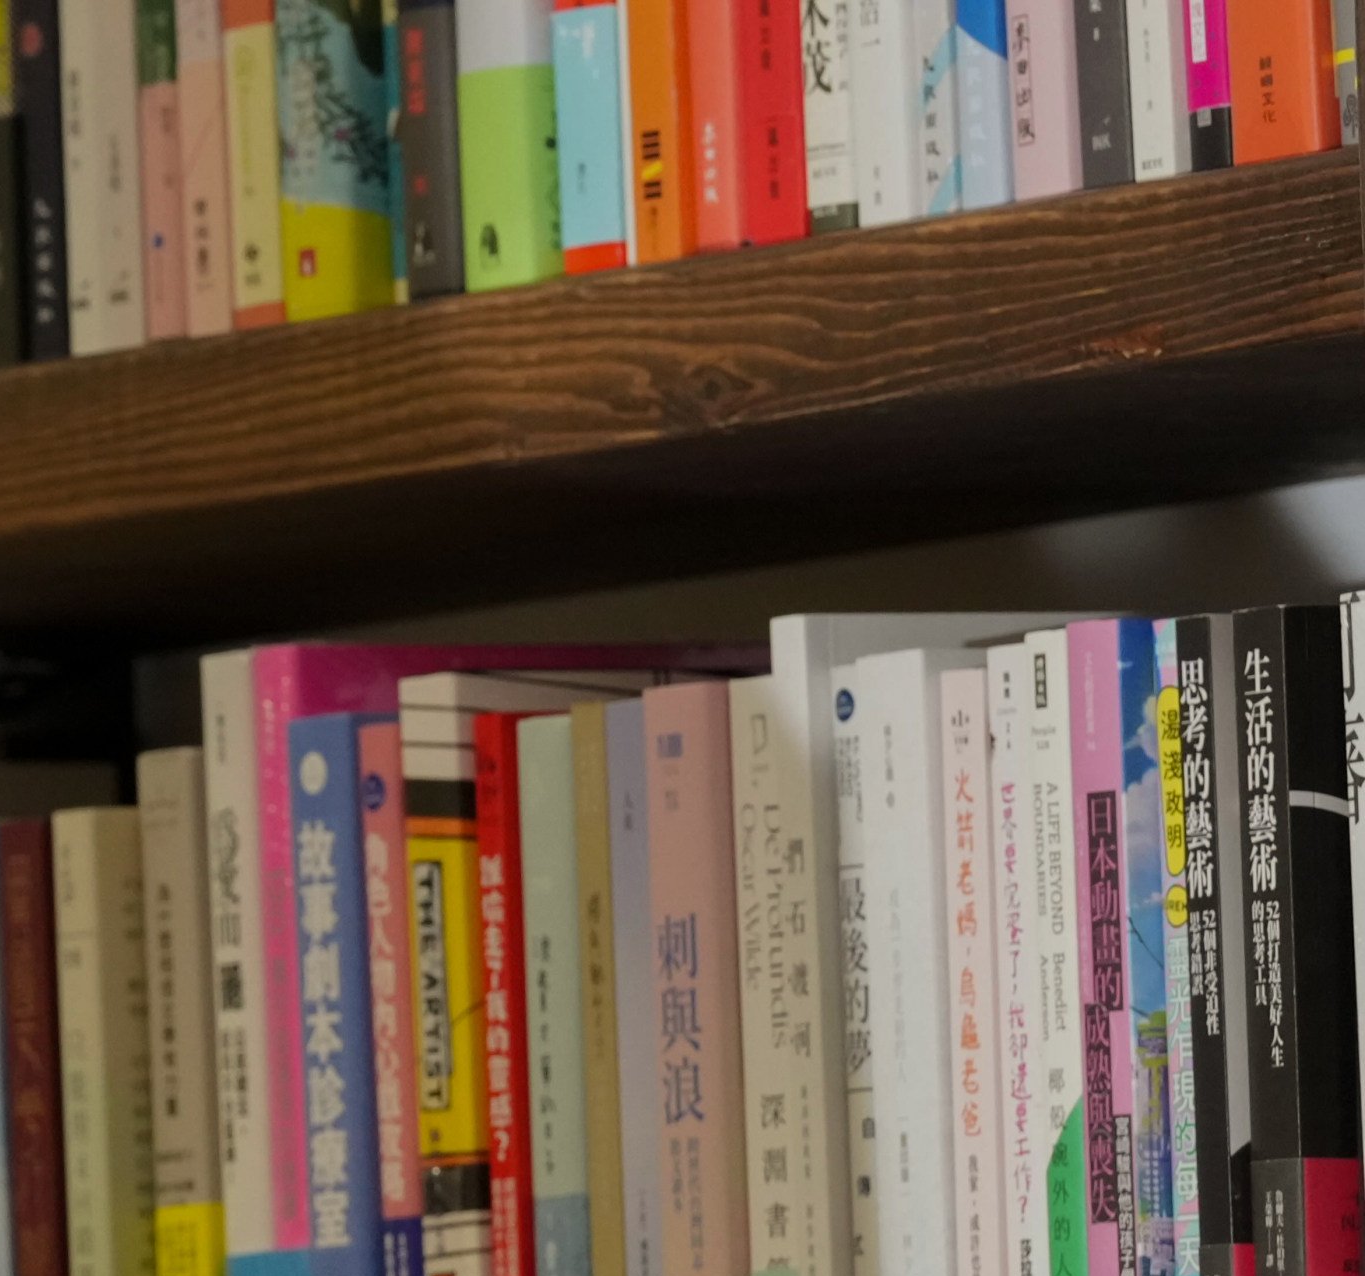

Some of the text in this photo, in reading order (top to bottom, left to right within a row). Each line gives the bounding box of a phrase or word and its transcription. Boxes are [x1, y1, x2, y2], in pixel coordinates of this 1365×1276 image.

[1179, 657, 1214, 899] 思考的藝術
[1243, 648, 1277, 893] 生活的藝術
[1034, 783, 1046, 916] BOUNDARIES
[1049, 845, 1065, 935] BEYOND
[656, 912, 707, 1124] 刺與浪
[1039, 951, 1066, 1041] Benedict Anderson
[1188, 910, 1220, 1036] 52個非受迫性 思考錯誤
[1251, 900, 1286, 1068] 52個打造美好人生 的思考工具
